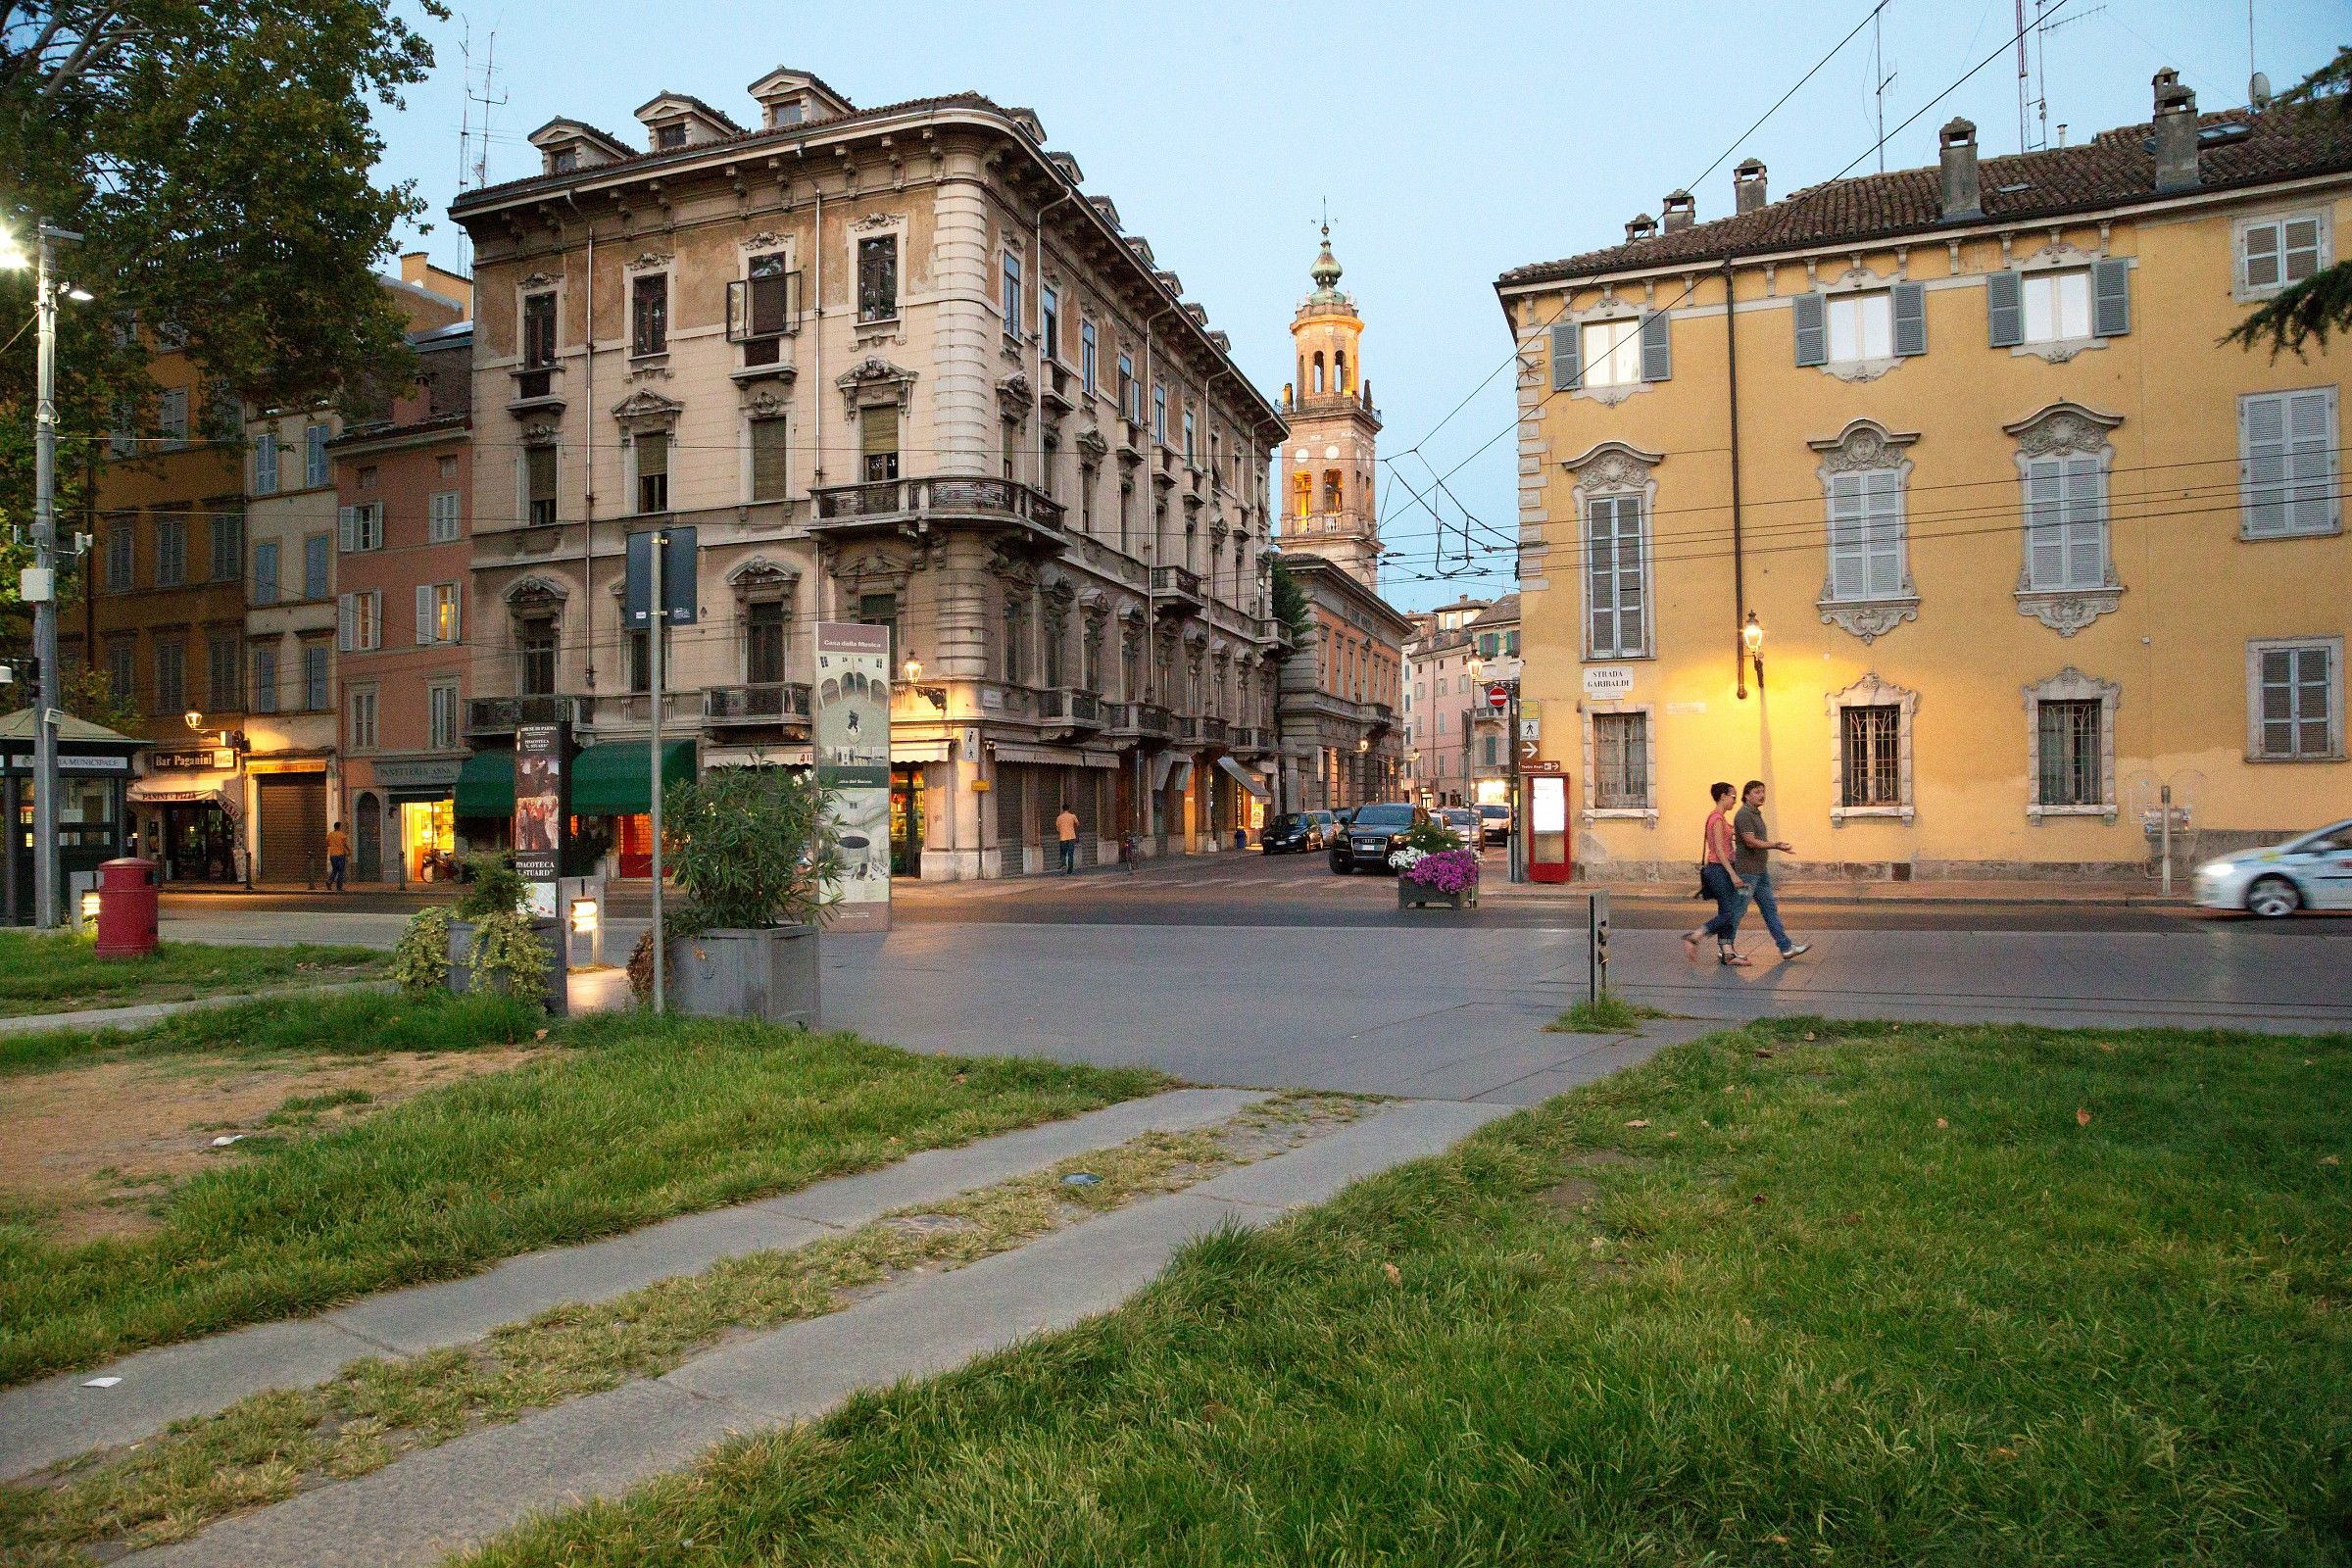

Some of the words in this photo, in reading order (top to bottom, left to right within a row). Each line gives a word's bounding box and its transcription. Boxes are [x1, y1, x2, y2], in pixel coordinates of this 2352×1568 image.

[156, 756, 171, 766] Bar
[173, 754, 213, 767] Paganini
[221, 801, 239, 818] BAR
